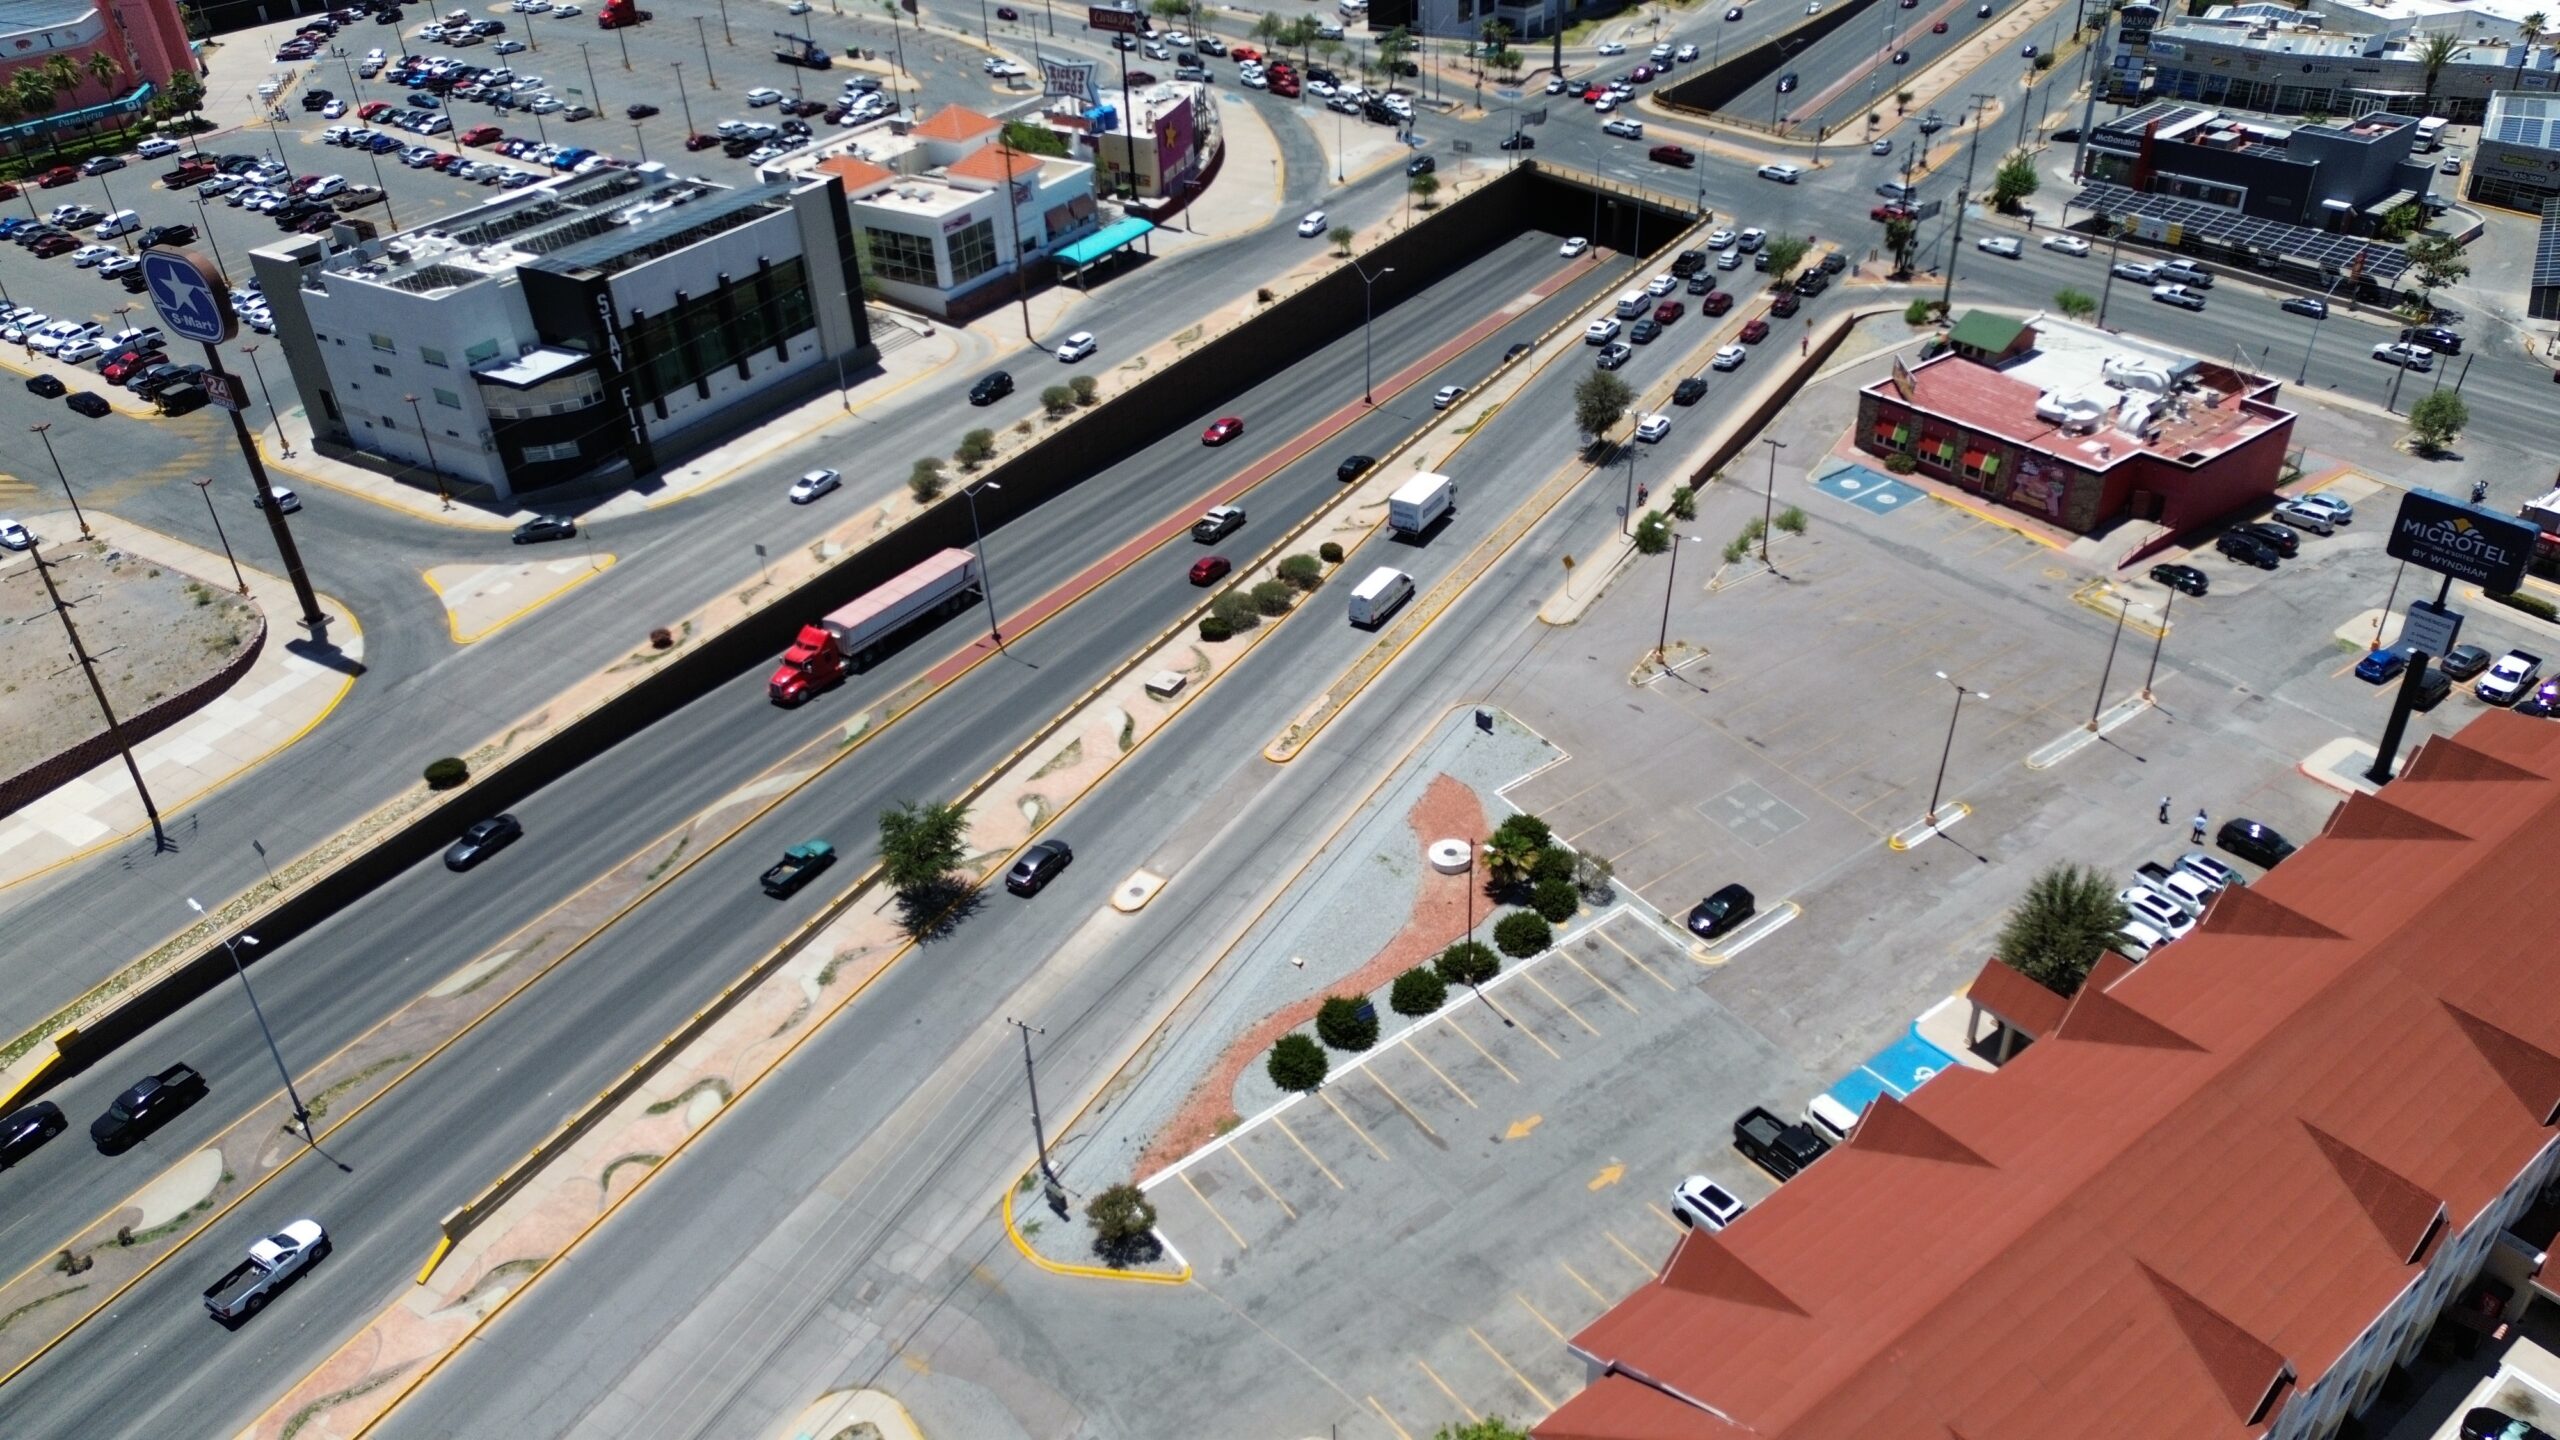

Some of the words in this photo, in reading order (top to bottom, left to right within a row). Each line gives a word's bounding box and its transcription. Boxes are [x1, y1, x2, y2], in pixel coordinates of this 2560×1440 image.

[1051, 80, 1084, 95] TACOS
[2095, 133, 2141, 148] McDonald's
[172, 312, 215, 332] S-Mart
[596, 293, 623, 373] STAY
[207, 377, 228, 397] 24
[620, 386, 641, 445] FIT
[2401, 519, 2510, 566] MICROTEL
[2411, 548, 2427, 560] BY
[2430, 554, 2488, 580] WYNDHAM
